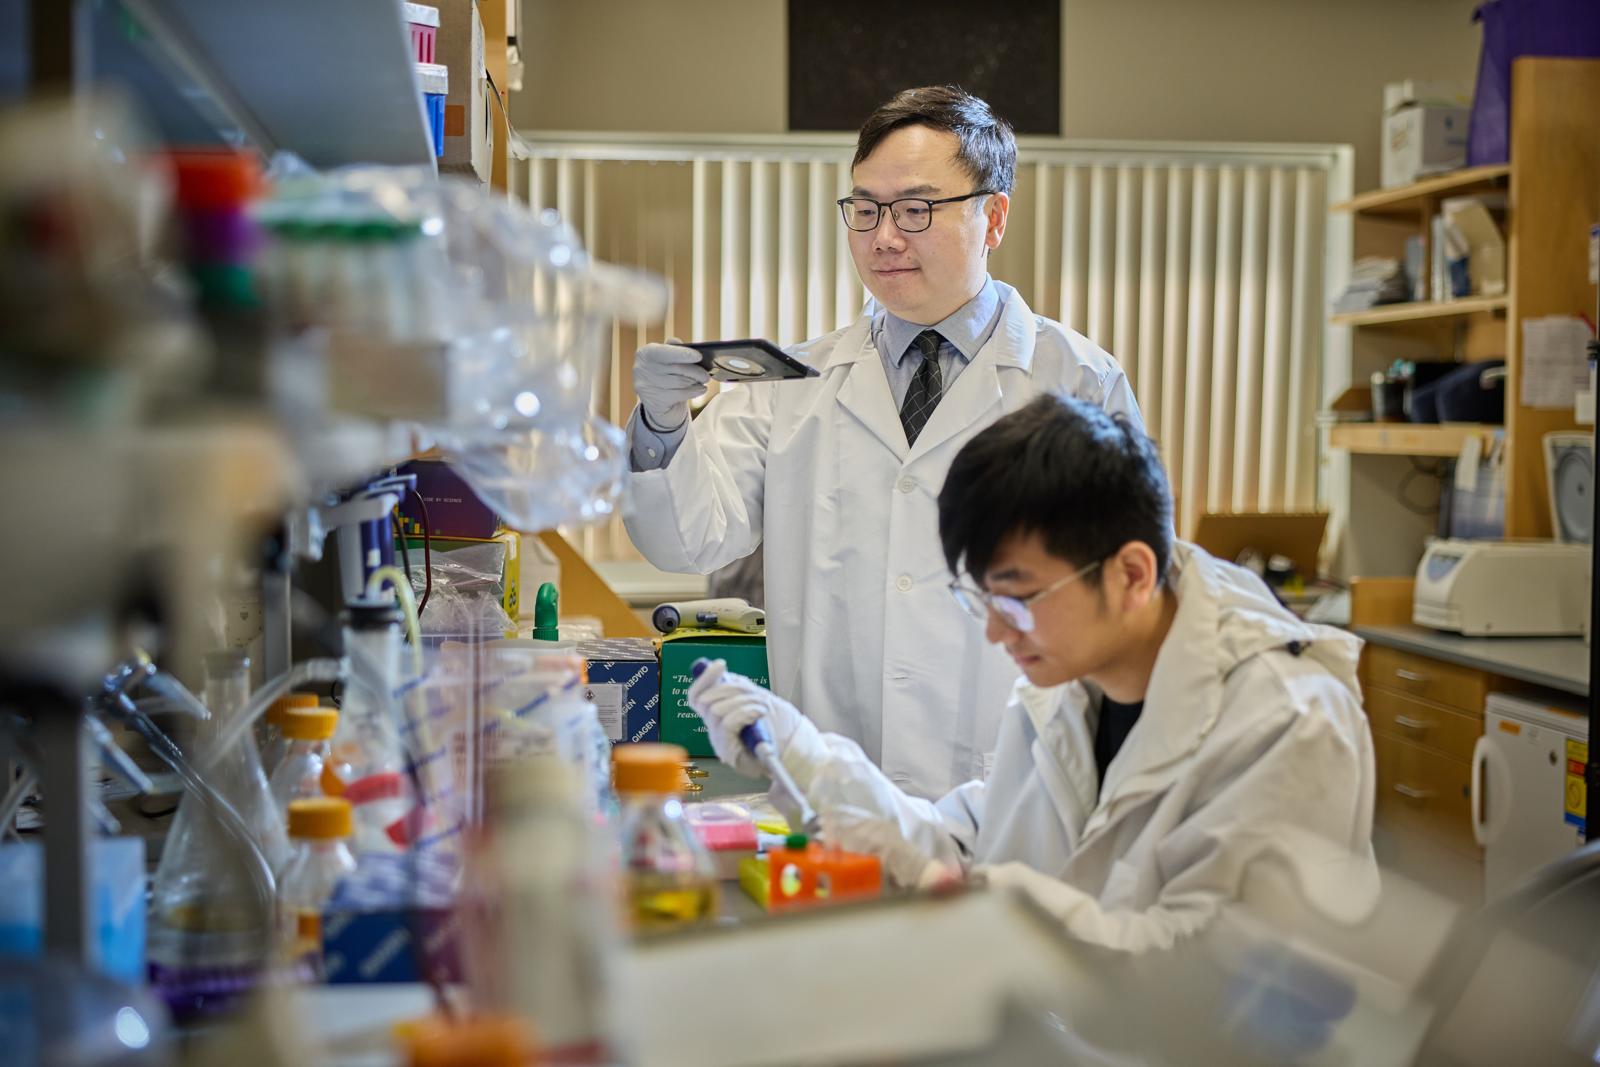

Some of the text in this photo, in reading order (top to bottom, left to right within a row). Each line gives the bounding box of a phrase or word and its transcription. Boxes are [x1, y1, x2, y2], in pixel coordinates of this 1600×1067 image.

[624, 665, 649, 690] QIAGEN
[759, 675, 768, 684] is
[672, 687, 681, 695] to
[622, 698, 637, 716] GEN
[644, 694, 659, 711] GEN
[631, 718, 657, 743] QIAGEN
